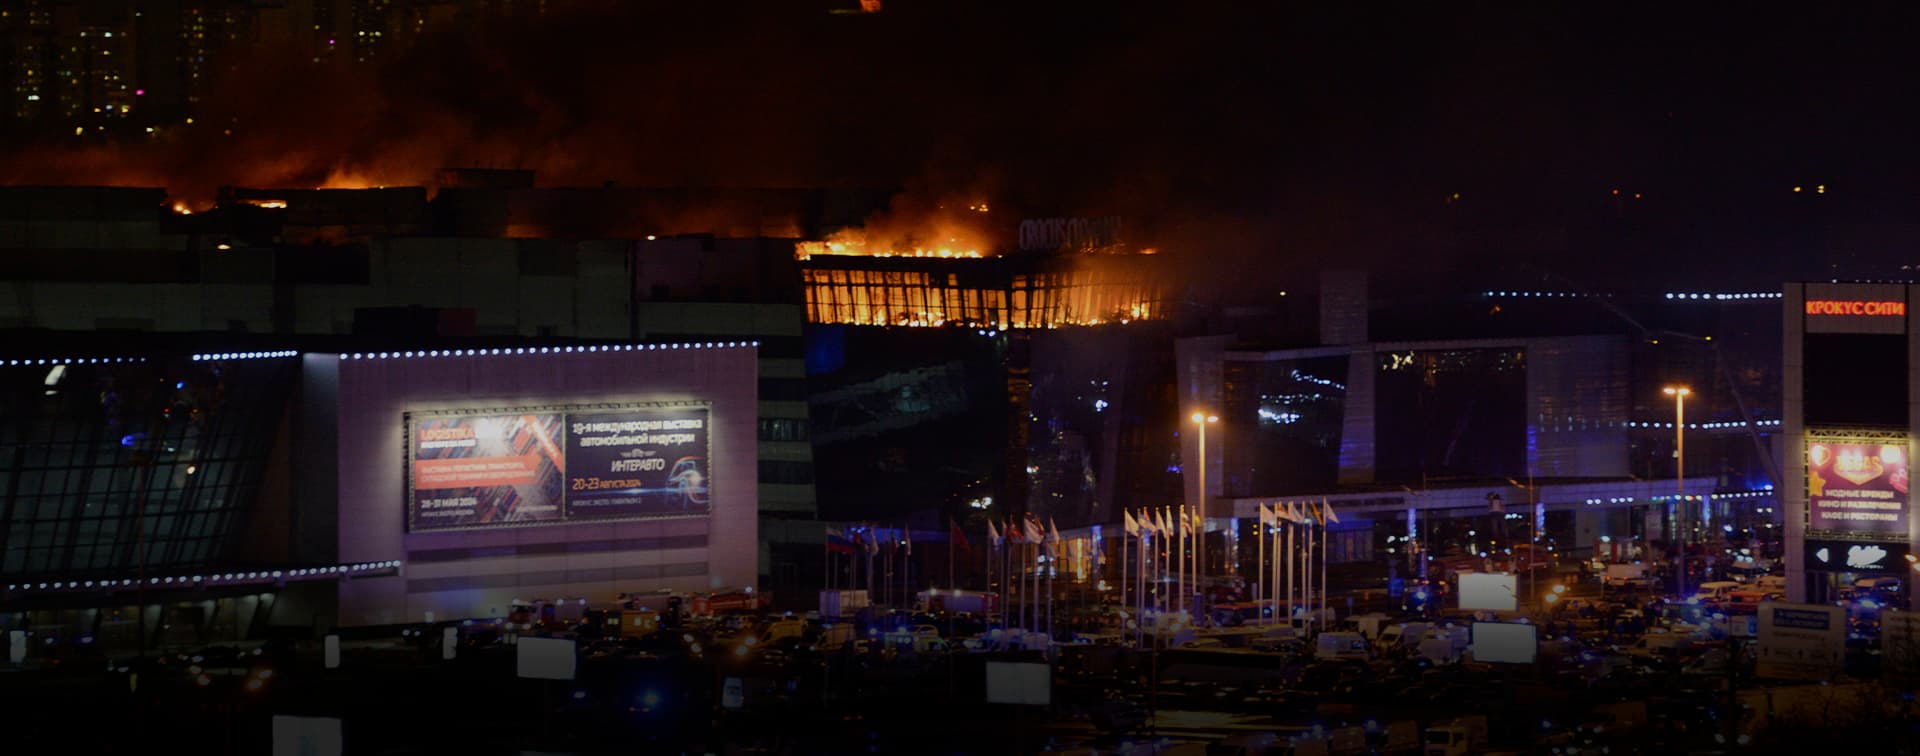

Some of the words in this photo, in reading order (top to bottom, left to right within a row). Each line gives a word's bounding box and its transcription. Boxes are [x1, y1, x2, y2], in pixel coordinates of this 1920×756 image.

[1019, 217, 1066, 250] CROCUS
[1806, 301, 1864, 315] КРОКУС
[1864, 301, 1905, 315] СИТИ
[572, 423, 591, 435] 19-я
[592, 420, 662, 434] международная
[663, 419, 703, 430] выставка
[579, 432, 648, 447] автомобильной
[648, 433, 695, 447] индустрии
[611, 458, 666, 473] ИНТЕРАВТО
[572, 477, 599, 490] 20-23
